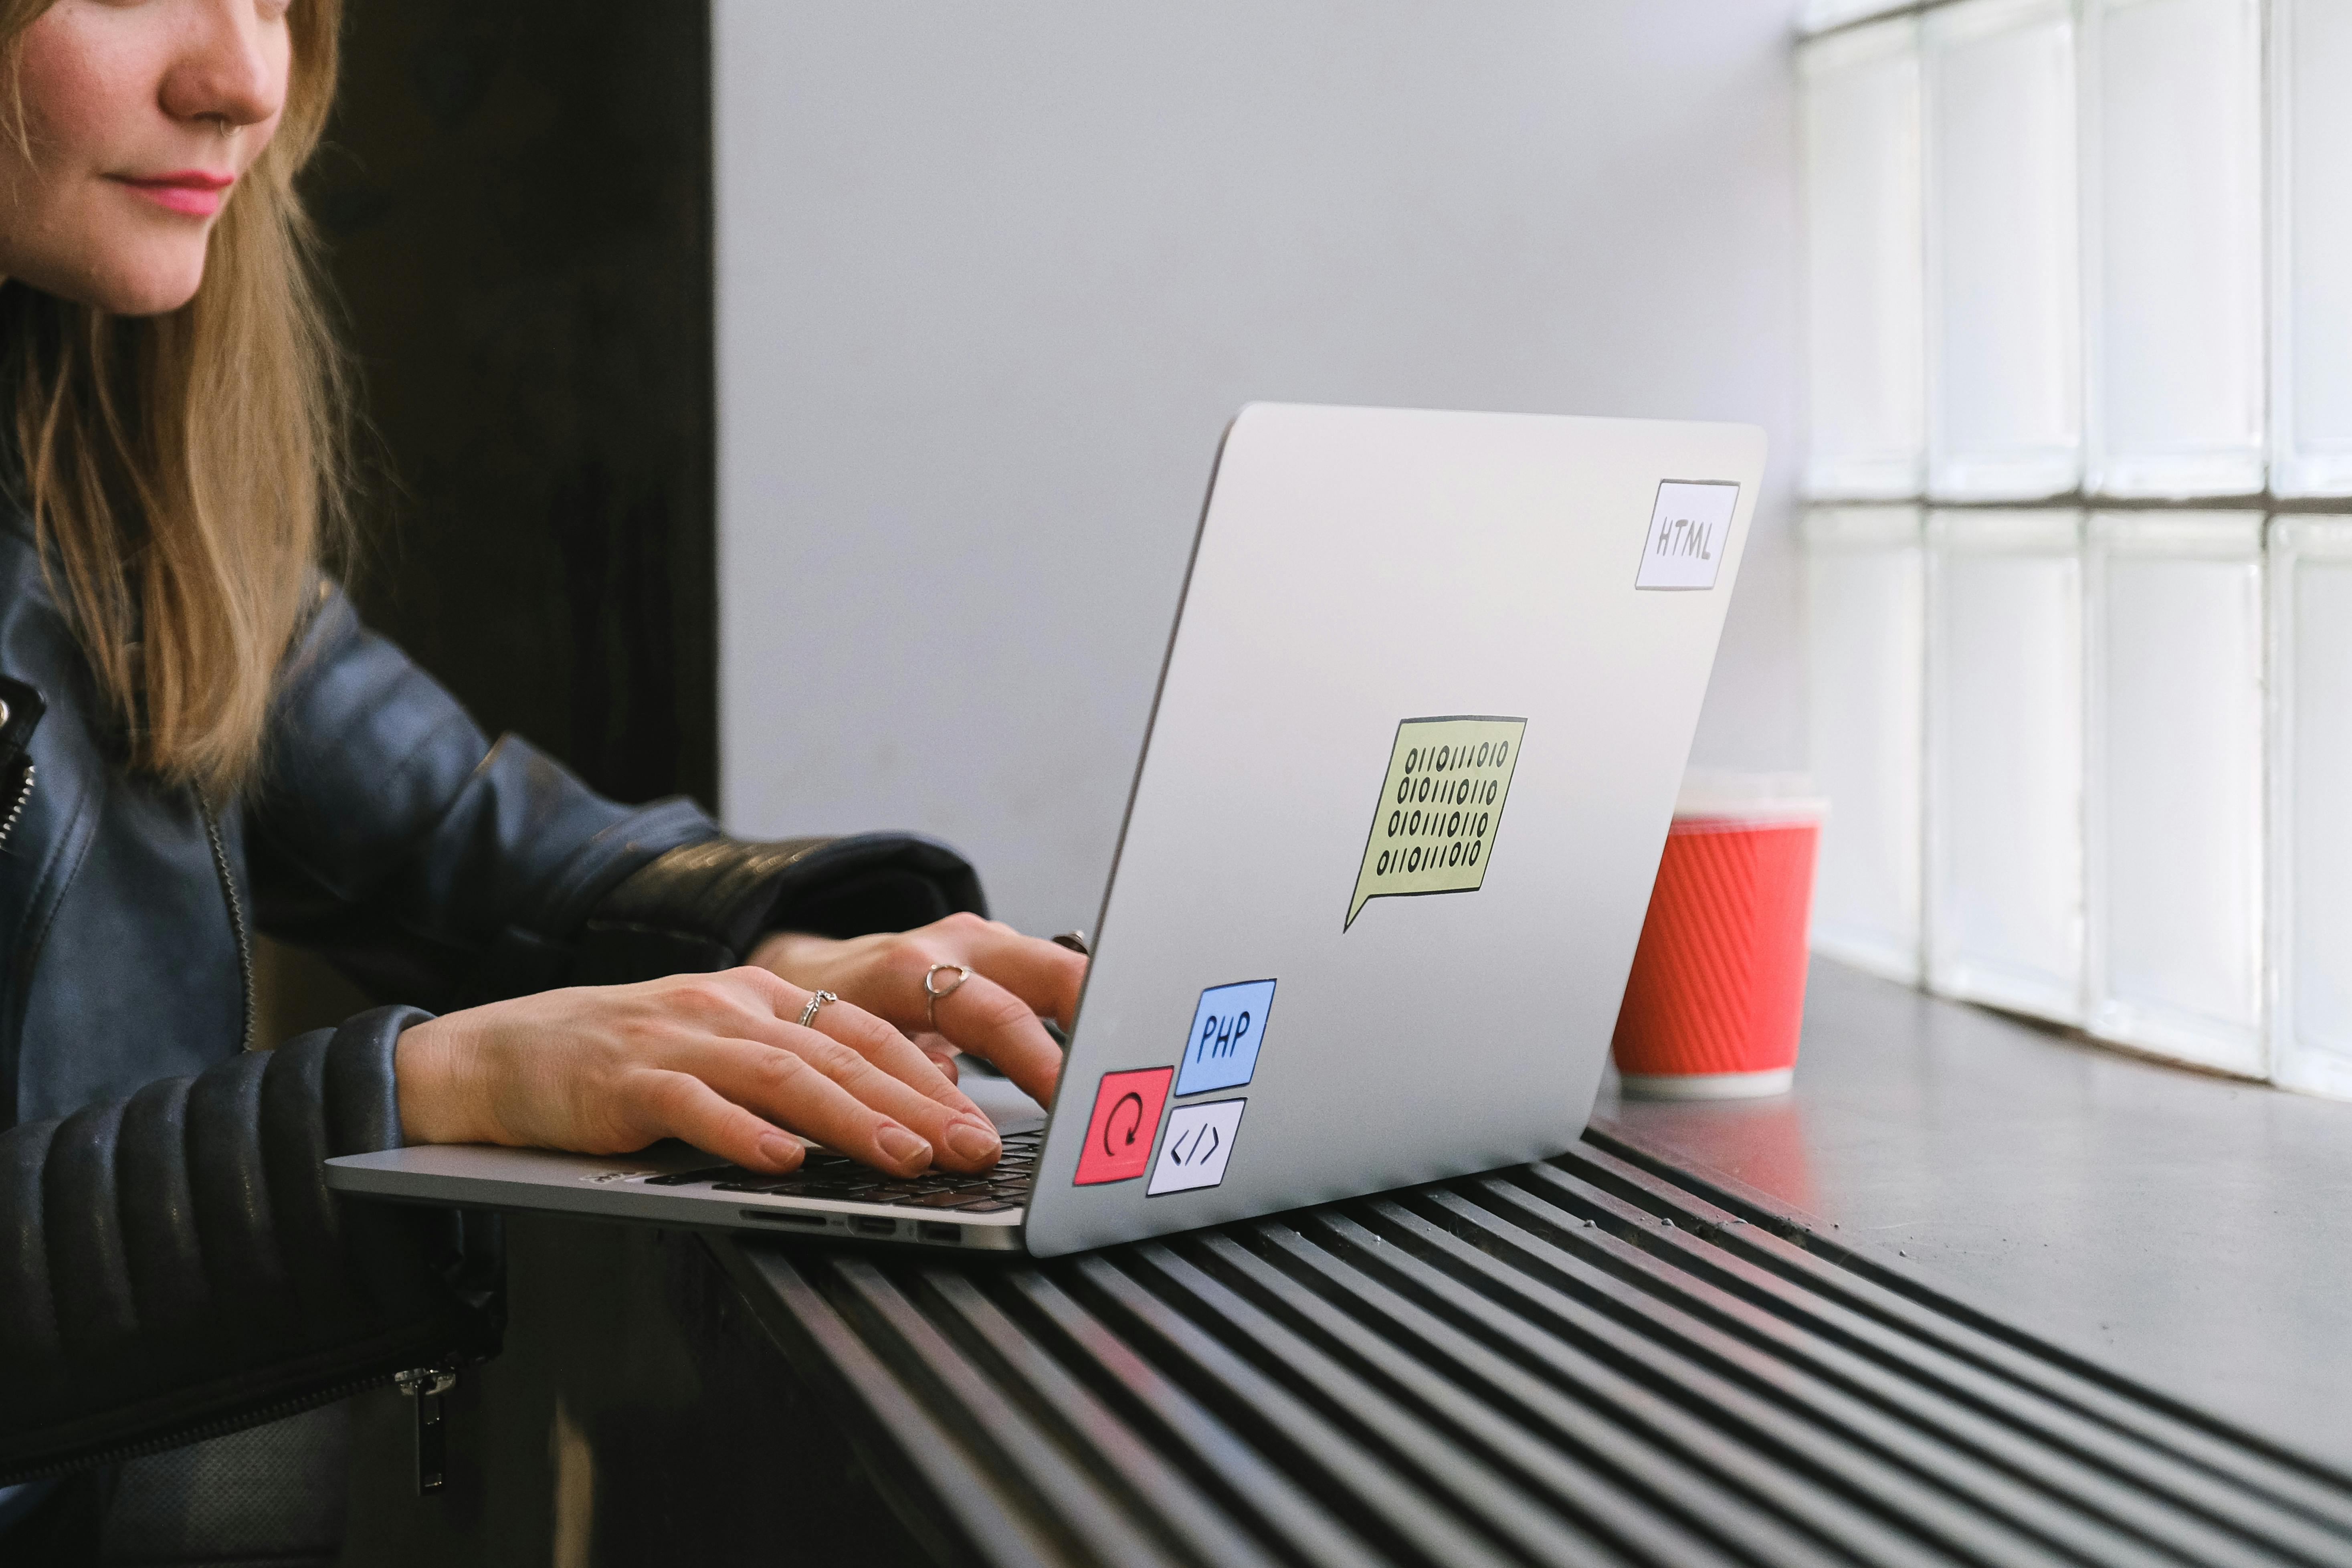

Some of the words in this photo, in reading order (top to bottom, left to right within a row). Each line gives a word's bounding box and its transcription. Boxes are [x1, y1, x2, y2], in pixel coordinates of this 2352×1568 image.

[1656, 516, 1712, 560] HTML
[1405, 741, 1508, 774] 0110111010
[1397, 777, 1497, 806] 0101110110
[1388, 810, 1488, 838] 0101110110
[1377, 840, 1481, 876] 0110111010
[1197, 1011, 1250, 1063] PHP
